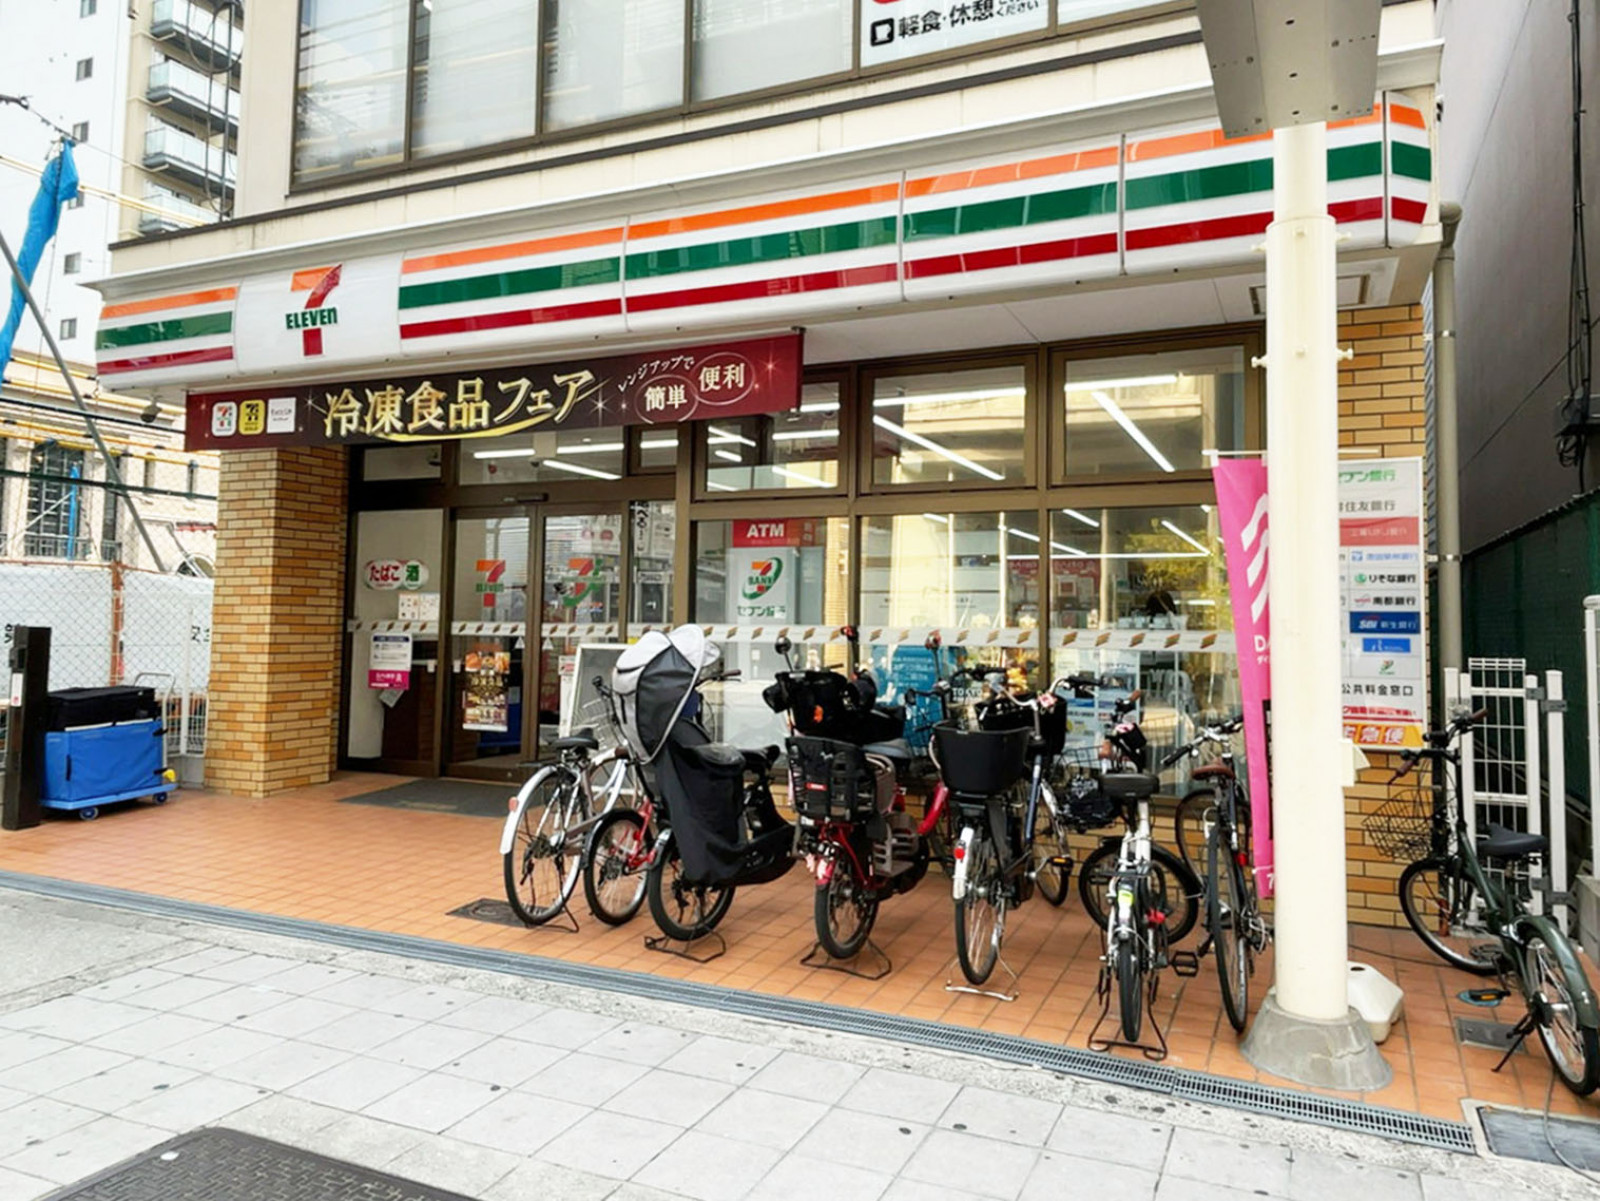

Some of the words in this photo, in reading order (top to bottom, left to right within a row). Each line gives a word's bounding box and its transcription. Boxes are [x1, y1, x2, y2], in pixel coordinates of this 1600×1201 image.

[290, 263, 343, 357] 7
[617, 355, 695, 392] レンジアップで
[699, 362, 746, 393] 便利
[324, 369, 596, 438] 冷凍食品フェア
[644, 384, 688, 412] 簡単
[746, 523, 785, 538] ATM
[369, 564, 400, 581] たばこ
[406, 565, 420, 582] 酒
[1342, 684, 1414, 696] 公共料金窓口
